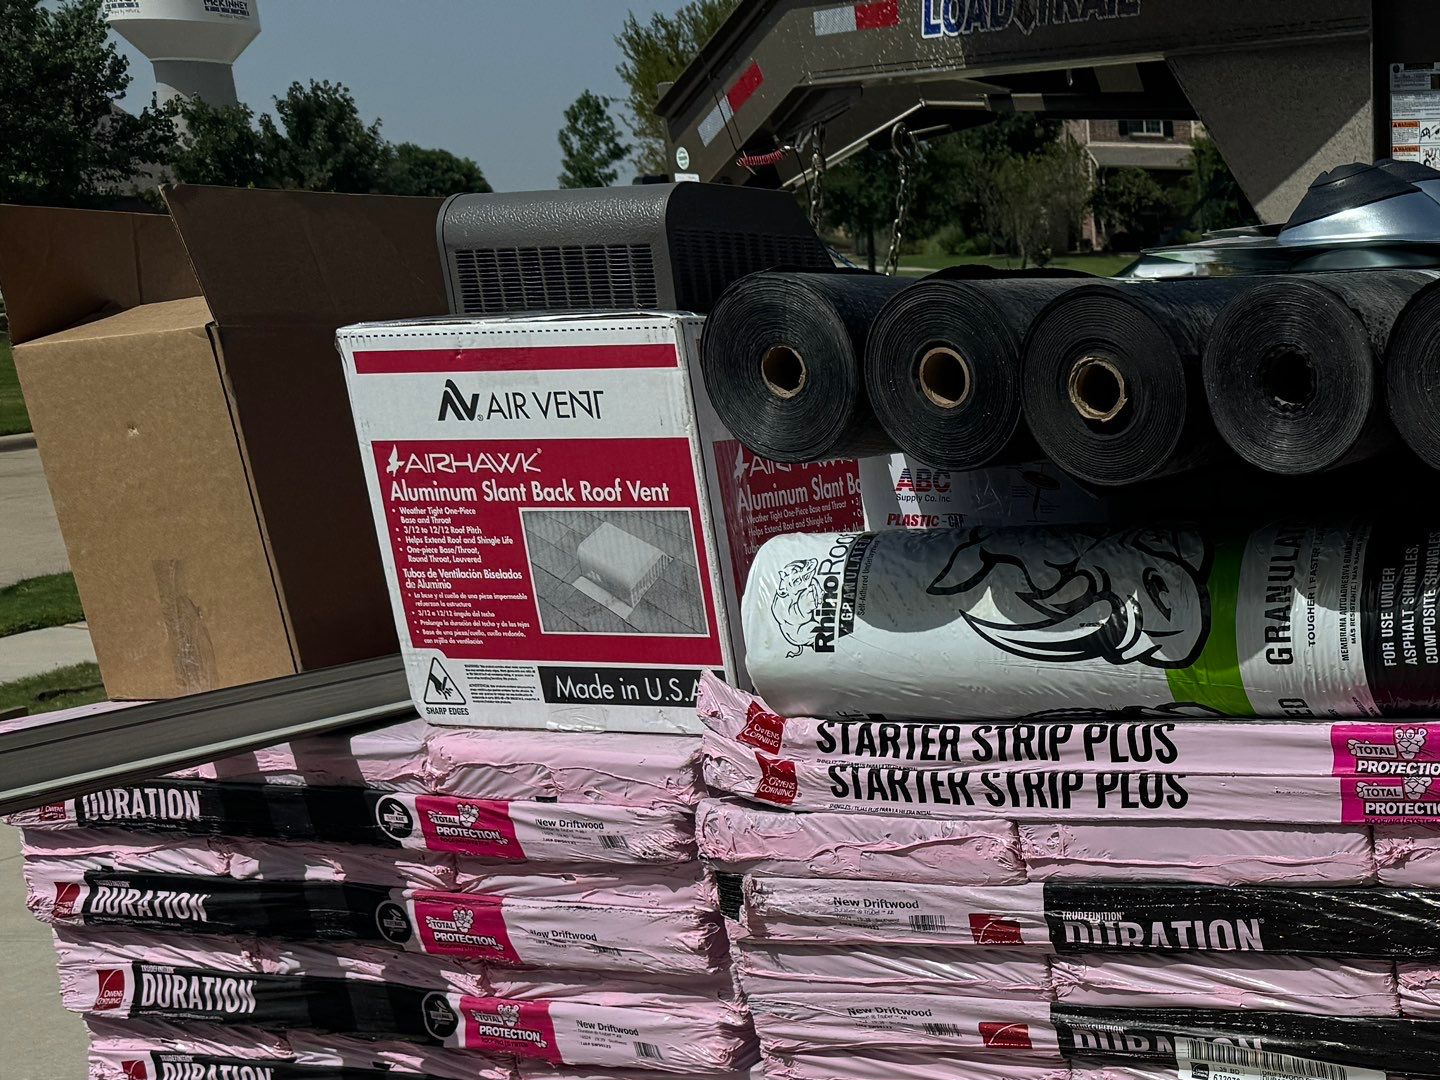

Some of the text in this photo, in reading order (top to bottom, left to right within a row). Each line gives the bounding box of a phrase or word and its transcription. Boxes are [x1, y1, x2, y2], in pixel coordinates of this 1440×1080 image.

[486, 391, 604, 420] AIR VENT
[404, 452, 541, 474] AIRHAWK
[390, 478, 669, 502] Aluminum Slant Back Roof Vent
[737, 474, 845, 513] Aluminum Slant
[399, 507, 476, 516] Weather Tight One-Piece
[400, 516, 451, 524] Base and Throat
[887, 514, 940, 527] PLASTIC
[403, 526, 420, 534] 3/12
[429, 526, 449, 534] 12/12
[450, 526, 465, 534] Roof
[466, 526, 482, 534] Pitch
[405, 536, 423, 545] Helps
[424, 536, 445, 544] Extend
[477, 537, 500, 546] Shingle
[501, 537, 513, 545] Life
[406, 546, 480, 556] One-piece Base/Throat,
[429, 556, 452, 564] Throat,
[402, 568, 426, 579] Tubos
[427, 568, 437, 579] de
[483, 569, 522, 580] Biselados
[405, 579, 452, 589] de Aluminio
[814, 535, 856, 653] RhinoRoo
[1307, 592, 1317, 647] TOUGHER
[1381, 567, 1397, 667] FOR USE UNDER
[1423, 588, 1438, 664] COMPOSITE
[1402, 609, 1418, 666] ASPHALT
[556, 674, 615, 700] Made
[620, 679, 639, 700] in
[426, 707, 470, 716] SHARP EDGES
[816, 719, 1179, 764] STARTER STRIP PLUS
[1357, 745, 1394, 756] TOTAL
[829, 765, 1190, 809] STARTER STRIP PLUS
[1365, 786, 1400, 797] TOTAL
[535, 818, 604, 830] New Driftwood
[436, 827, 500, 840] PROTECTION
[90, 889, 208, 923] DURATION
[833, 897, 919, 909] New Driftwood
[141, 974, 255, 1013] DURATION
[479, 1025, 541, 1041] PROTECTION
[576, 1020, 639, 1036] New Driftwood
